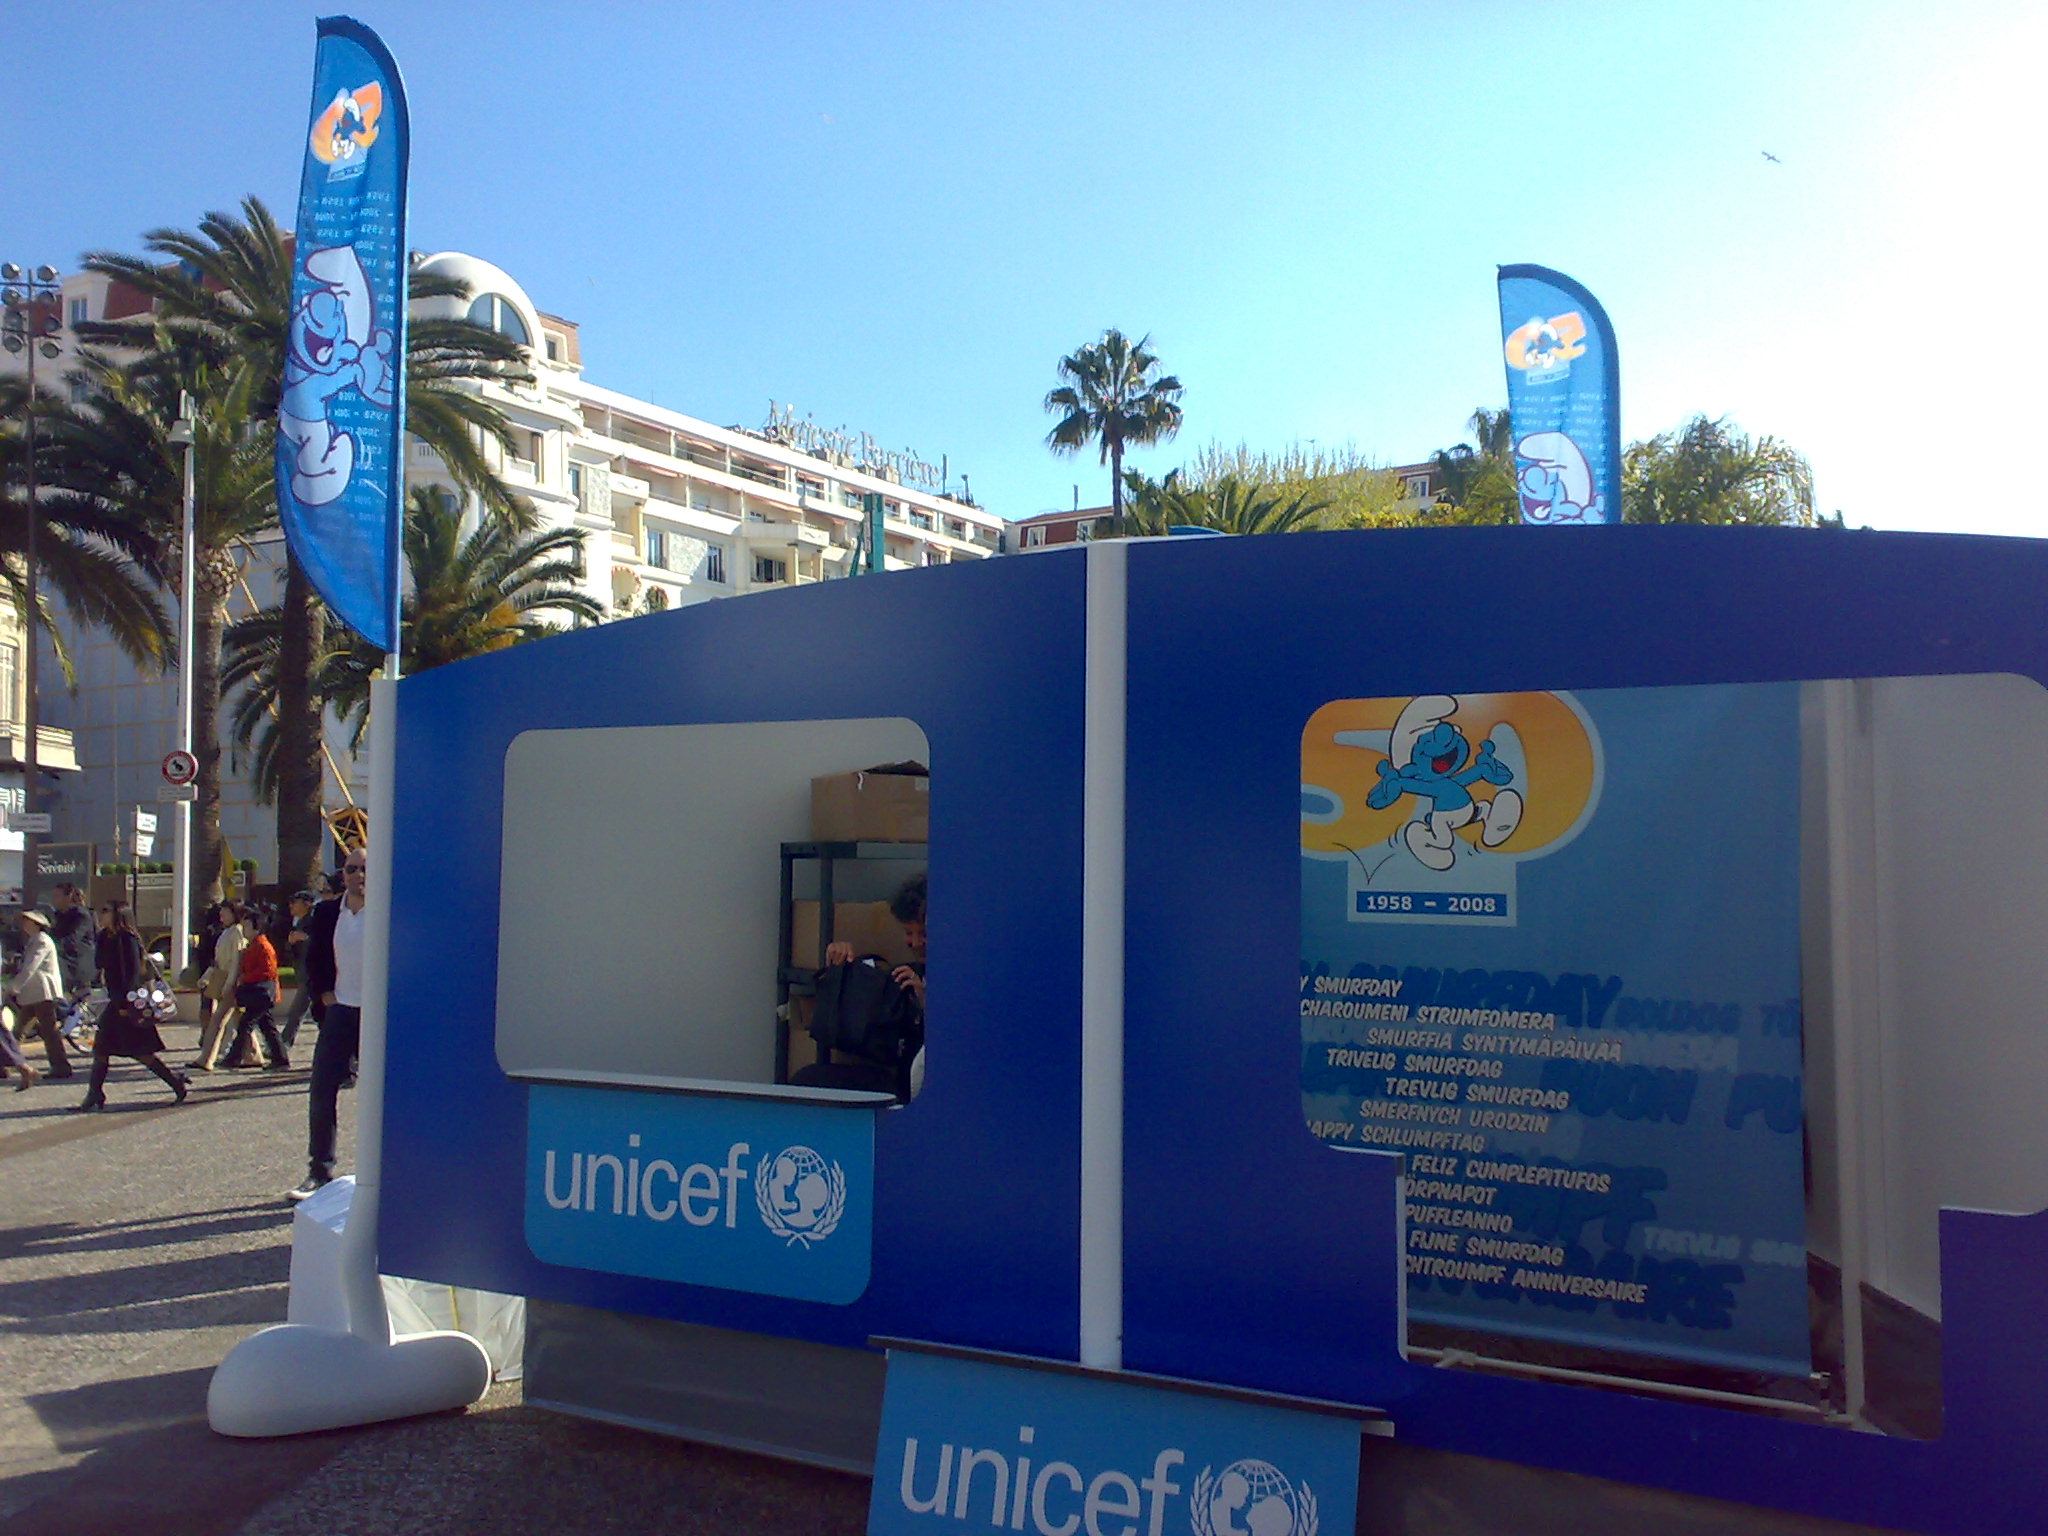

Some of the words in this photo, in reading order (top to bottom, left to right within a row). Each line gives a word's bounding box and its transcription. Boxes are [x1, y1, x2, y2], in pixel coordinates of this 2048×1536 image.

[1366, 895, 1413, 911] 1958
[1447, 897, 1496, 912] 2008
[1313, 976, 1403, 999] SMURFDAY
[1300, 998, 1409, 1022] CHAROUMENI
[1416, 1005, 1556, 1031] STRUMFOMERA
[1367, 1027, 1453, 1050] SMURFFIA
[1462, 1033, 1624, 1063] SYNTYMÄPÄIVÄÄ
[1326, 1048, 1396, 1071] TRIVELIG
[1403, 1054, 1504, 1078] SMURFDAG
[1385, 1076, 1459, 1100] TREVLIG
[1465, 1083, 1571, 1110] SMURFDAG
[1359, 1099, 1461, 1126] SMERFNYCH
[1469, 1109, 1552, 1134] URODZIN
[1306, 1119, 1353, 1141] APPY
[1360, 1122, 1486, 1153] SCHLUMPFTAG
[544, 1134, 750, 1229] unicef
[1411, 1154, 1459, 1176] FELIZ
[1465, 1159, 1612, 1194] CUMPLEPITUFOS
[1404, 1203, 1514, 1234] PUFFLEANNO
[1465, 1237, 1565, 1268] SMURFDAG
[1511, 1268, 1648, 1304] ANNIVERSAIRE
[900, 1426, 1185, 1536] unicef
